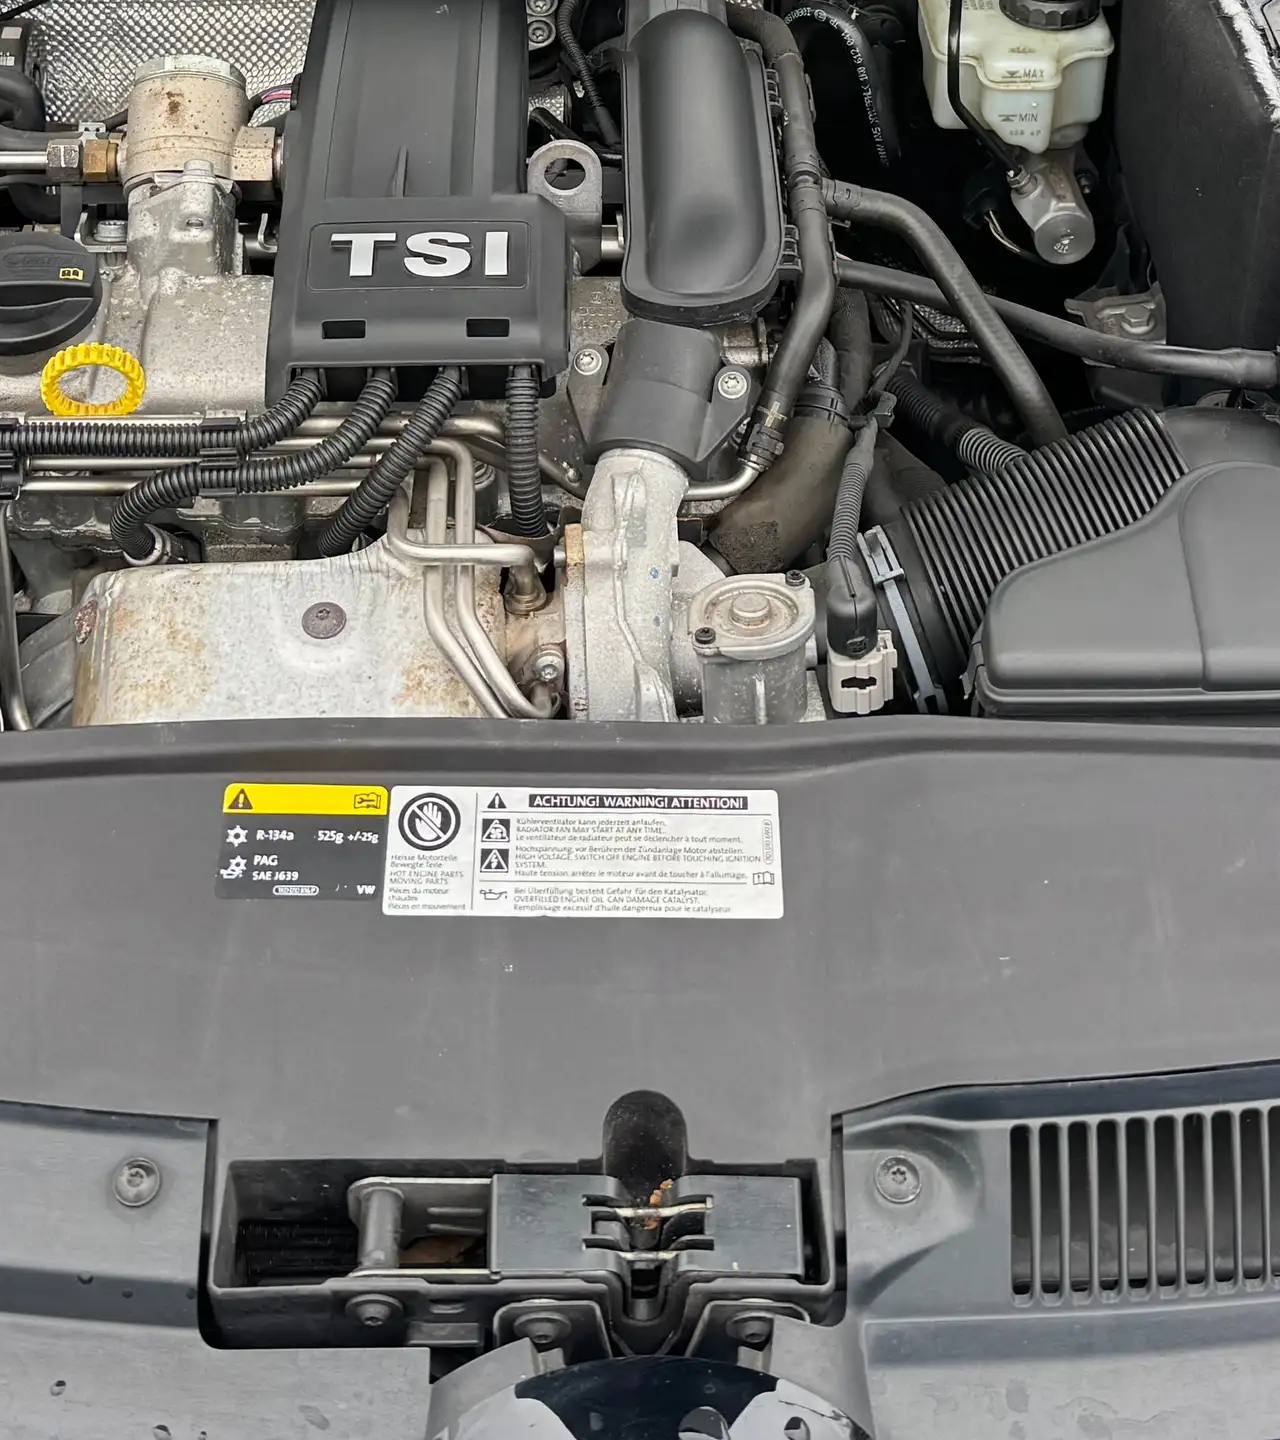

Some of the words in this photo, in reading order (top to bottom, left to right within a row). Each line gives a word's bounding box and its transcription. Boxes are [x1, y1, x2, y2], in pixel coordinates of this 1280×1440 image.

[1022, 68, 1045, 79] MAX
[1018, 113, 1038, 122] MIN
[330, 231, 509, 278] TSI
[533, 795, 600, 807] ACHTUNG!
[603, 796, 668, 808] WARNING!
[671, 797, 744, 809] ATTENTION!
[256, 829, 295, 841] R-134a
[317, 830, 344, 844] 525g
[346, 830, 380, 845] +/-25g
[615, 835, 632, 843] peut
[708, 836, 743, 844] moment.
[253, 854, 279, 866] PAG
[515, 853, 536, 861] HIGH
[622, 854, 652, 862] ENGINE
[652, 854, 681, 862] BEFORE
[683, 855, 724, 863] TOUCHING
[726, 855, 761, 863] IGNITION
[515, 861, 548, 869] SYSTEM.
[252, 871, 272, 881] SAE
[273, 871, 299, 881] J639
[408, 870, 438, 878] ENGINE
[515, 869, 538, 877] Haute
[606, 870, 635, 878] moteur
[659, 870, 669, 878] de
[669, 870, 698, 878] toucher
[389, 877, 424, 885] MOVING
[356, 884, 376, 895] VW
[575, 887, 604, 895] besteht
[606, 887, 633, 895] Gefahr
[560, 896, 590, 904] ENGINE
[591, 896, 605, 904] OIL
[607, 896, 625, 904] CAN
[626, 896, 660, 904] DAMAGE
[662, 897, 701, 905] CATALYST.
[513, 904, 561, 913] Remplissage
[562, 904, 593, 912] excessif
[621, 904, 662, 914] dangereux
[663, 905, 682, 914] pour
